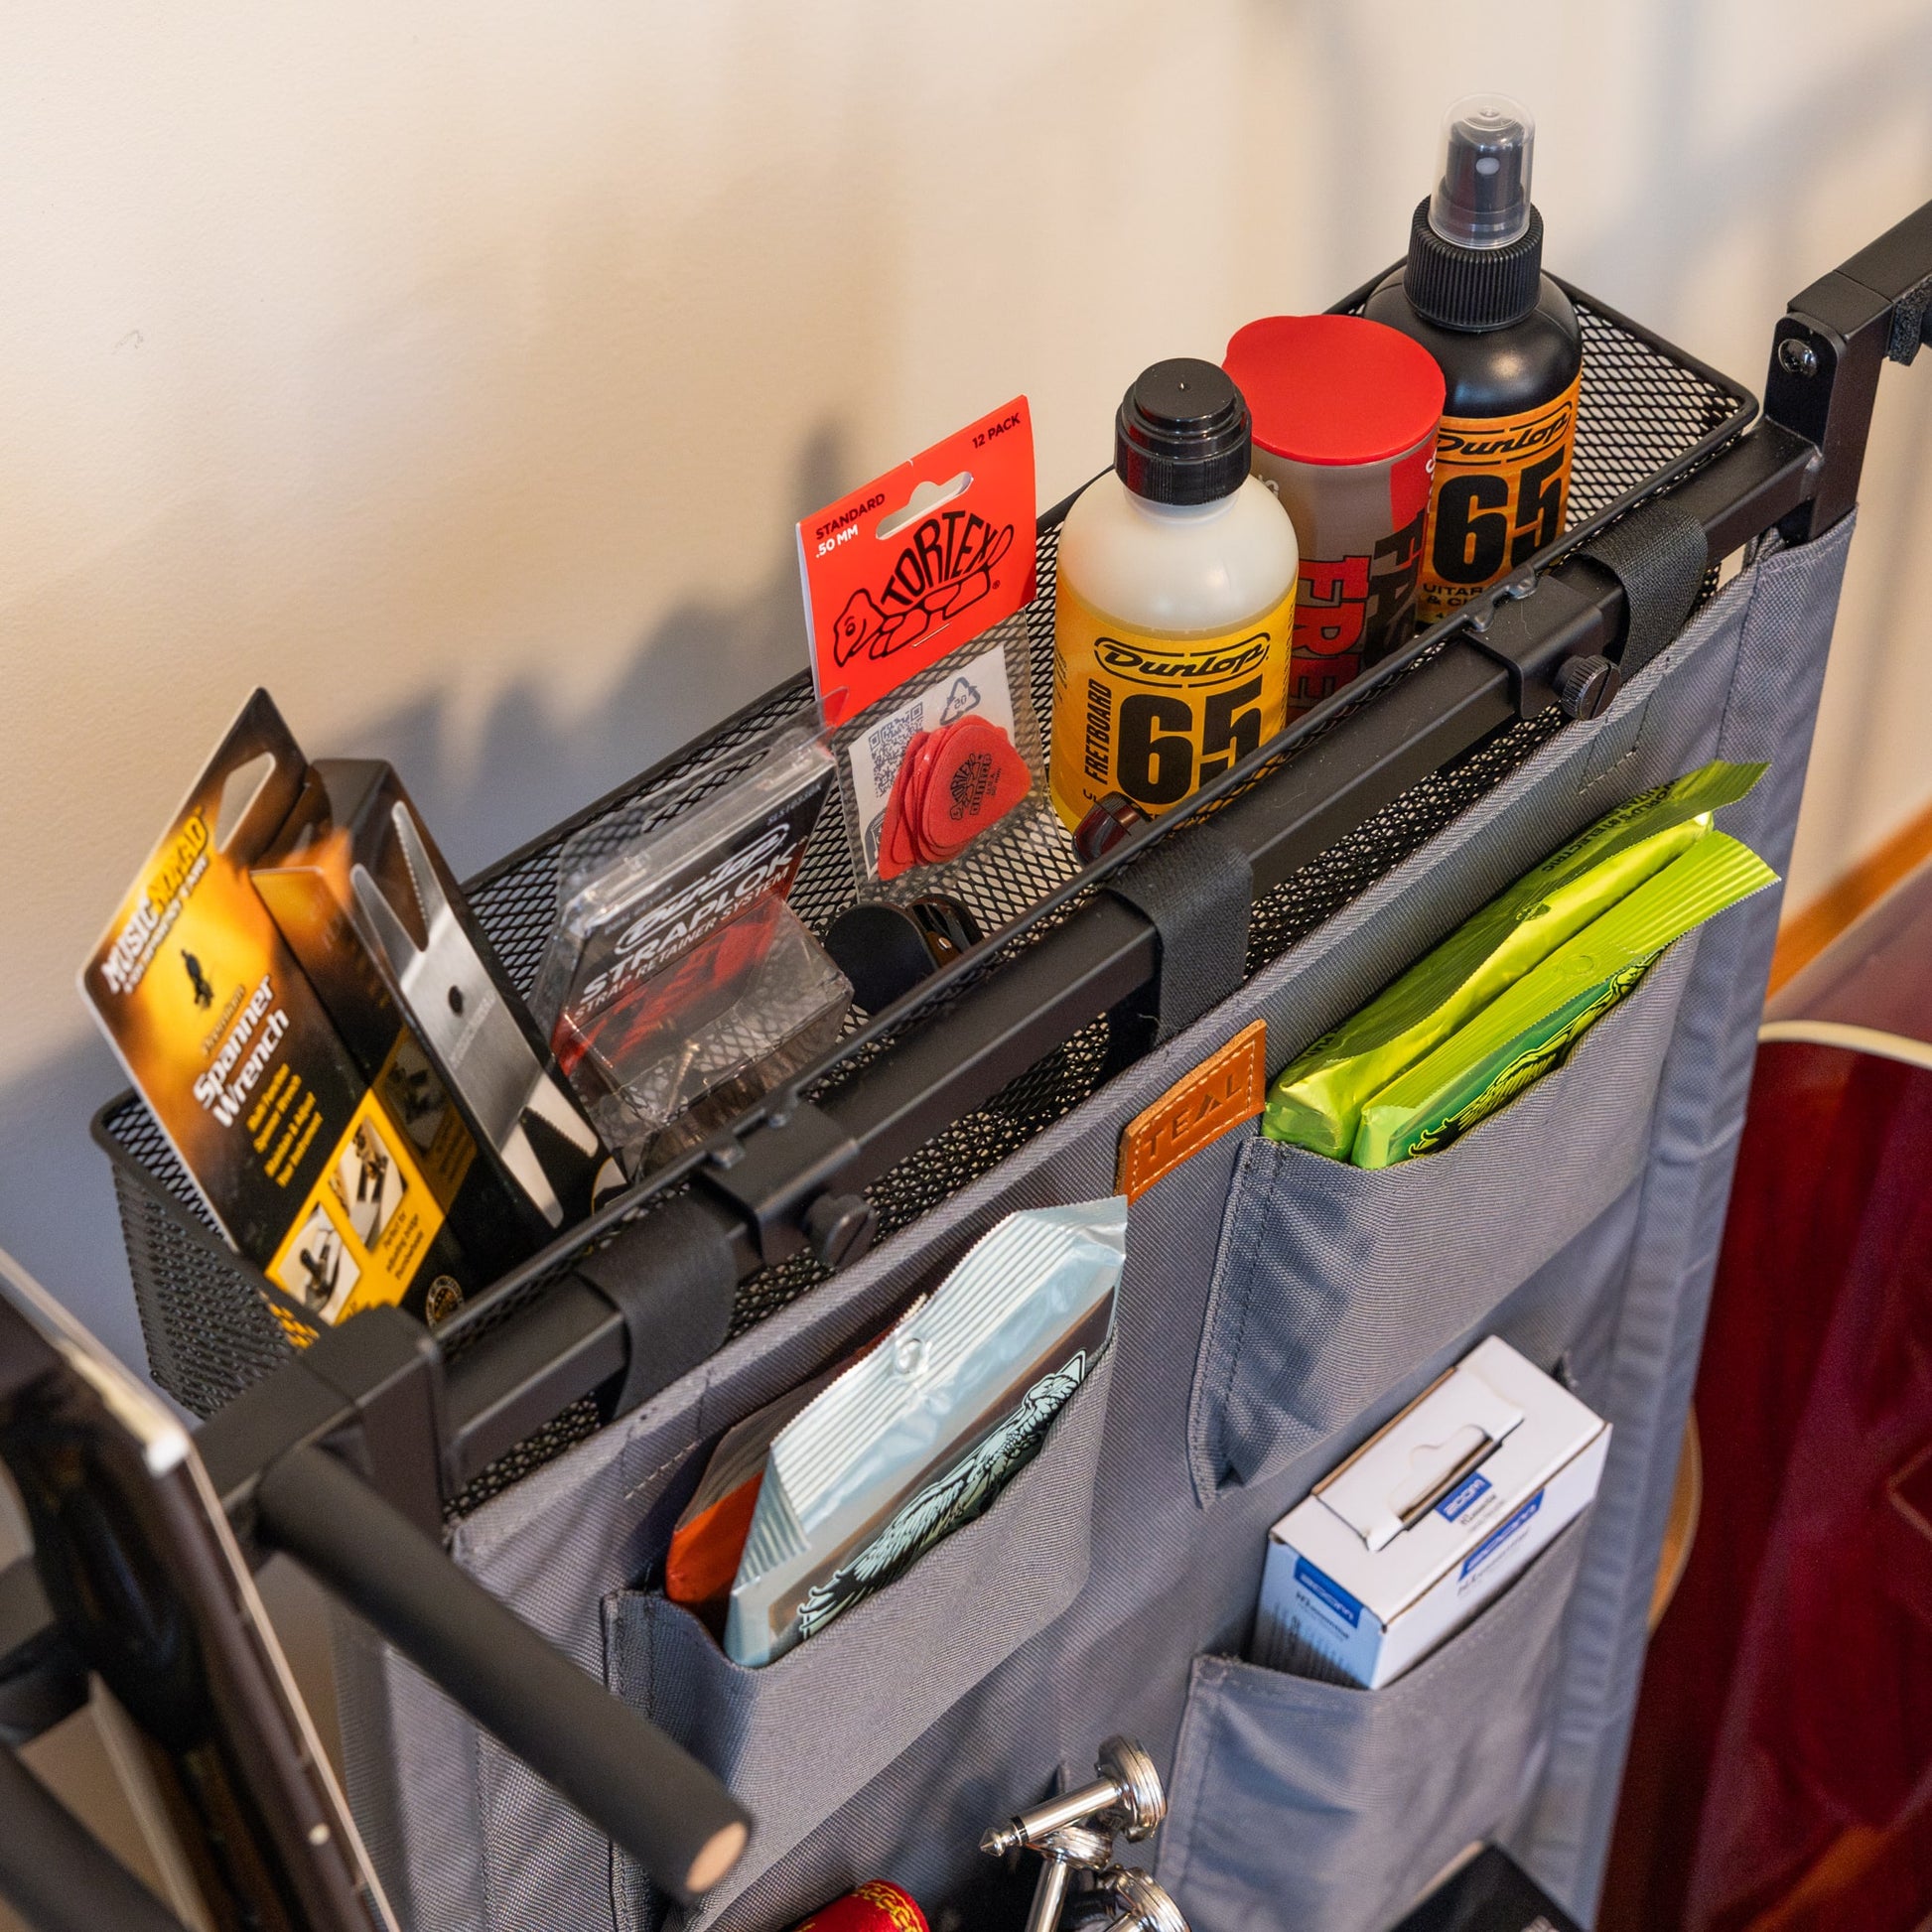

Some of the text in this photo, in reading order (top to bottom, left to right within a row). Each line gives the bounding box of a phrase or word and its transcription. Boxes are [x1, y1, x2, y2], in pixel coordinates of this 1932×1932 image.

[972, 412, 1021, 448] 12 PACK
[1437, 411, 1569, 456] Dunlop
[815, 493, 886, 540] STANDARD
[815, 524, 859, 558] .50 MM
[881, 510, 999, 606] TORTEX
[1432, 447, 1566, 585] 65
[1291, 555, 1372, 707] FRE
[1423, 583, 1483, 596] UITAR
[1102, 642, 1266, 678] Dunlop
[1083, 677, 1113, 785] FRETBOARD
[1116, 673, 1264, 805] 65
[573, 975, 635, 1022] STRAP
[636, 920, 719, 973] RETAINER
[721, 865, 790, 919] SYSTEM
[580, 842, 799, 1005] STRAPLOK
[193, 974, 275, 1110] Spanner
[212, 1008, 290, 1128] Wrench
[1143, 1073, 1242, 1162] TEAL
